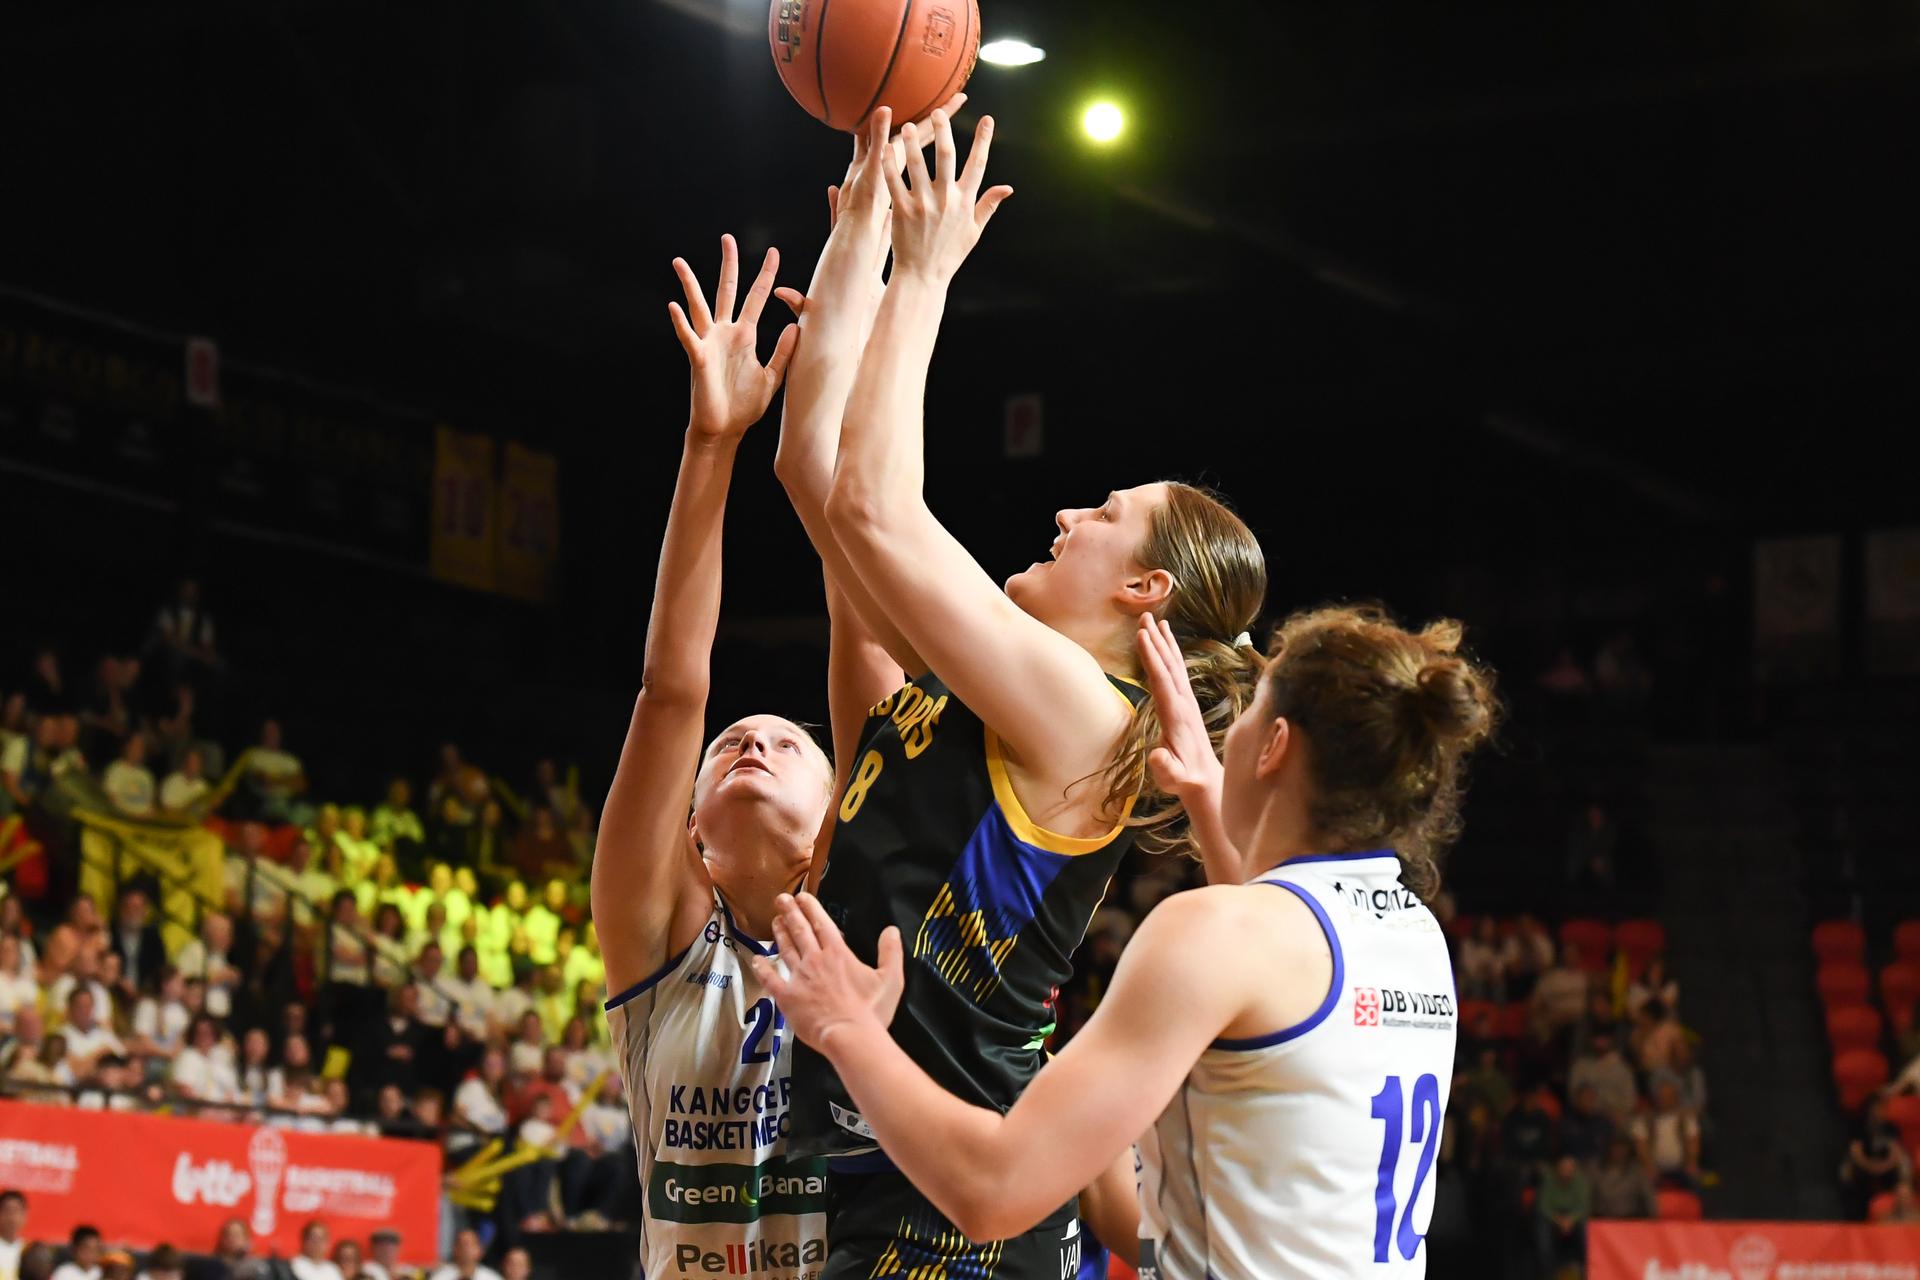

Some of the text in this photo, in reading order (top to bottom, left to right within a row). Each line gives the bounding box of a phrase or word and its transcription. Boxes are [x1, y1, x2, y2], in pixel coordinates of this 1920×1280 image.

[1381, 989, 1454, 1017] DB VIDEO
[665, 1118, 748, 1151] BASKET
[1370, 1073, 1441, 1264] 12
[665, 1174, 827, 1205] Green Bana
